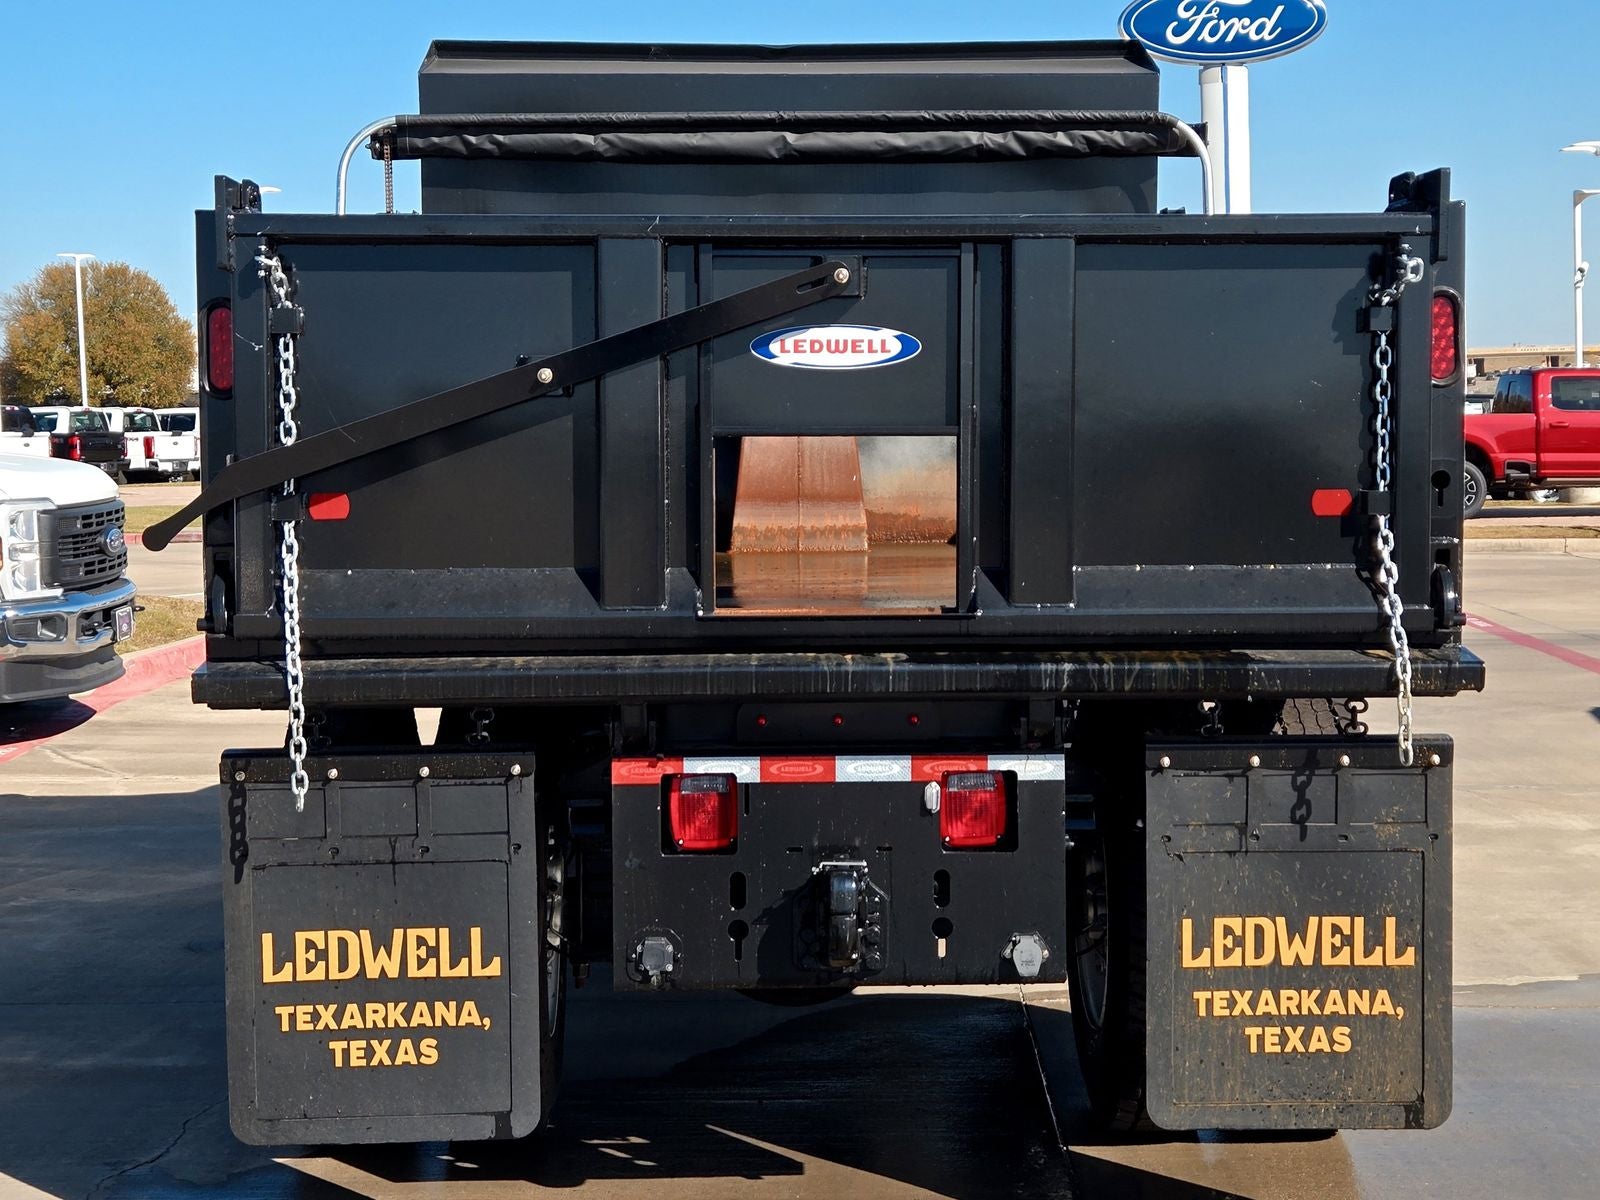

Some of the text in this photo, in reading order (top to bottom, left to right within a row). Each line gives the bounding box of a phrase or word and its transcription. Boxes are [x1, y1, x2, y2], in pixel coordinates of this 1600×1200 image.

[1165, 0, 1285, 44] Ford
[779, 338, 892, 355] LEDWELL
[260, 926, 502, 984] LEDWELL
[1181, 915, 1417, 969] LEDWELL
[274, 1000, 492, 1033] TEXARKANA,
[1192, 988, 1405, 1021] TEXARKANA,
[328, 1037, 440, 1069] TEXAS
[1243, 1025, 1353, 1055] TEXAS
